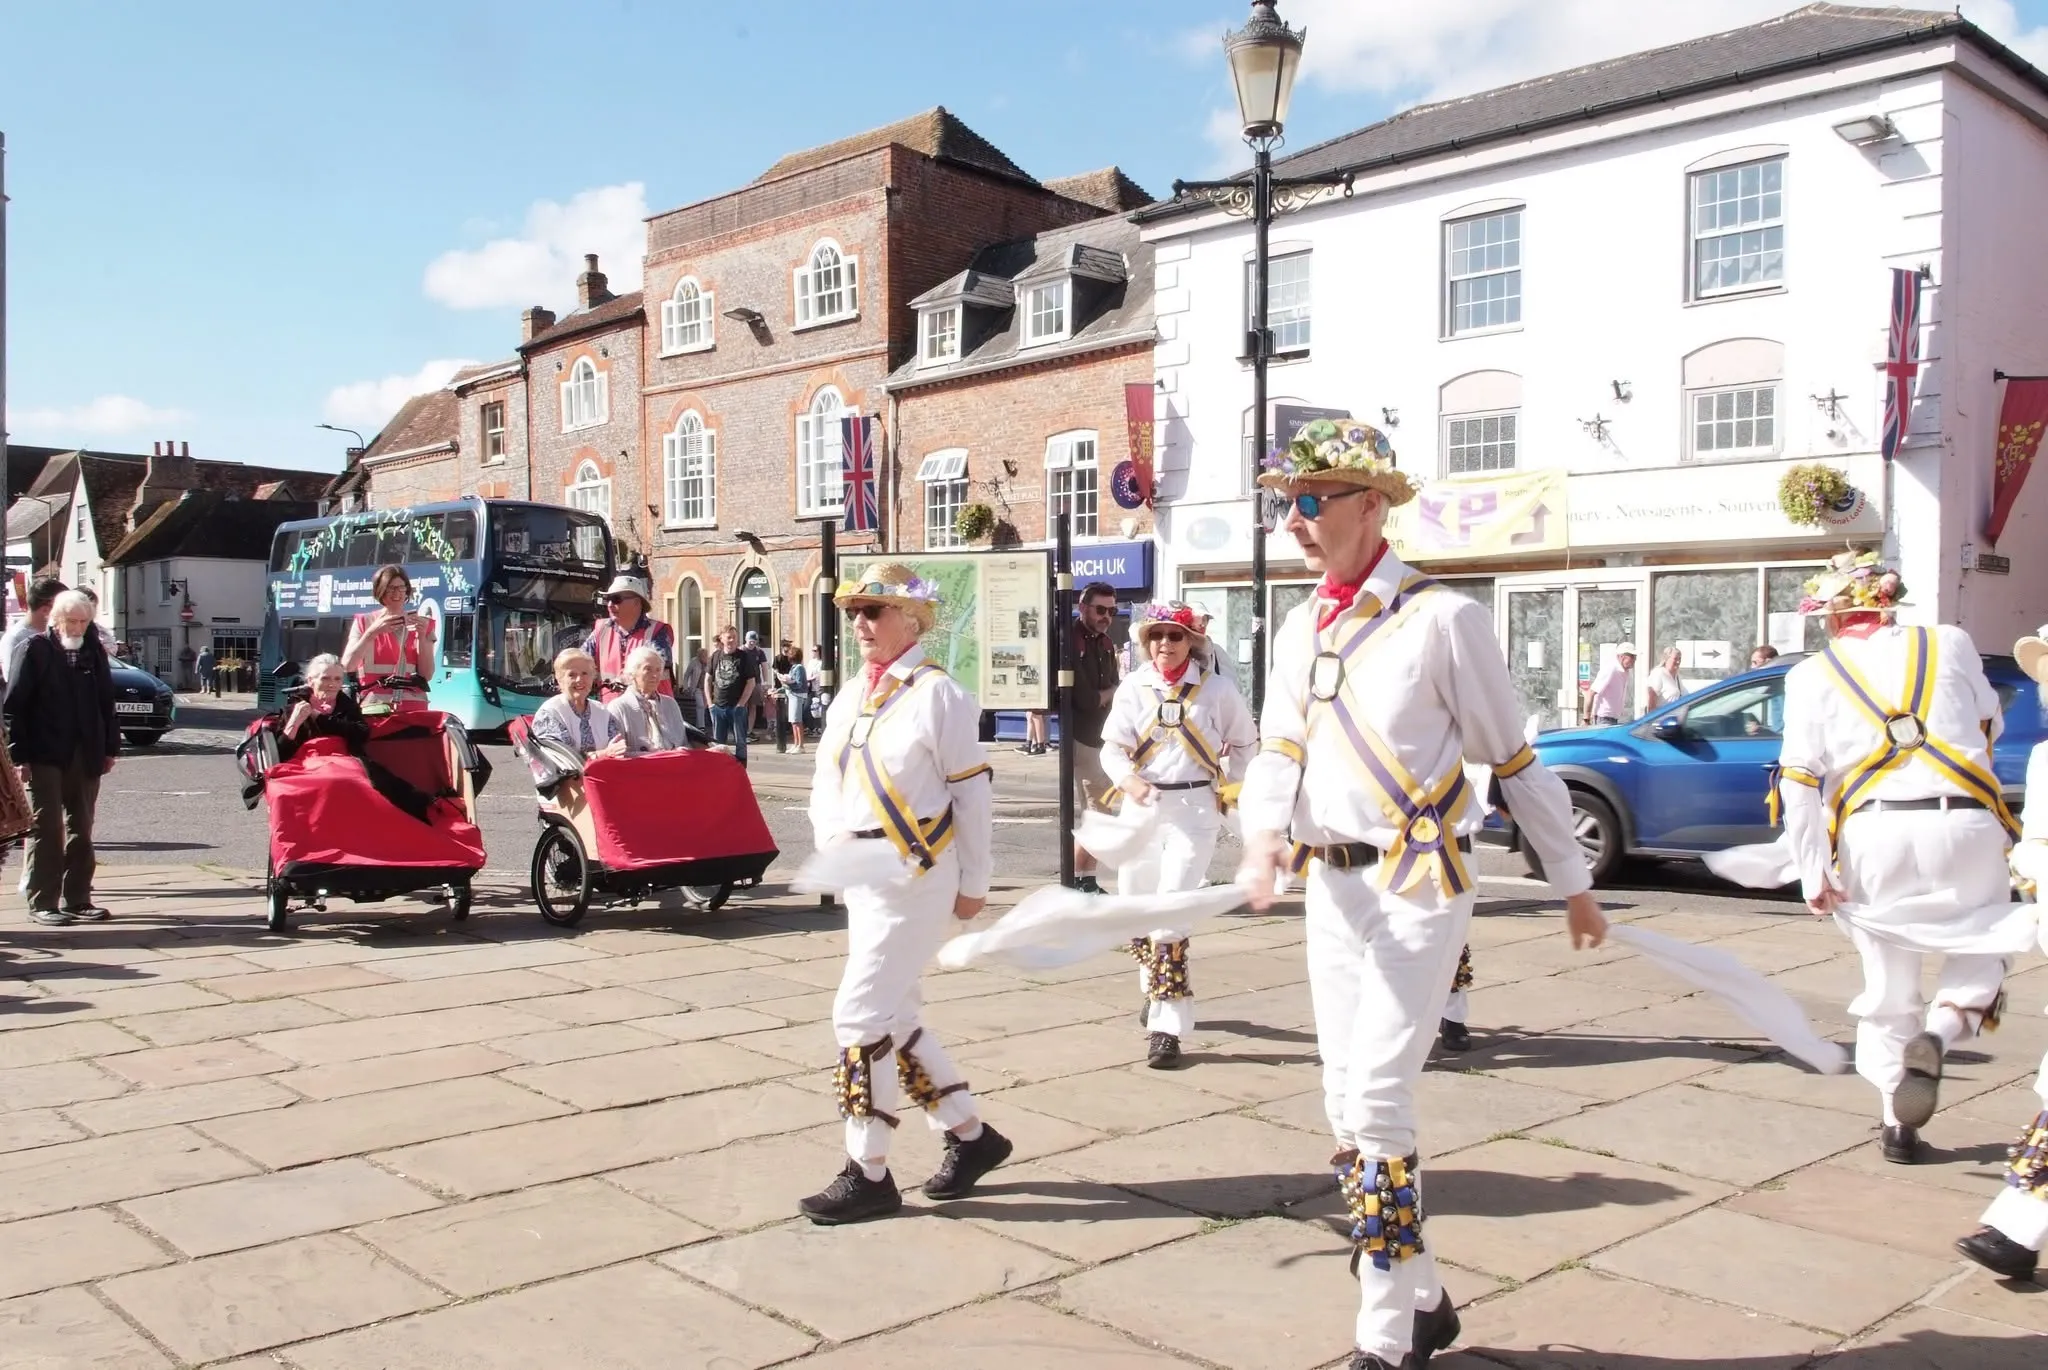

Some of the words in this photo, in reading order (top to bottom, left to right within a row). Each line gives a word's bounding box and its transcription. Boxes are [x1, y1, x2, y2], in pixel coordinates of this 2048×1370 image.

[1616, 503, 1704, 521] Newsagents
[1070, 559, 1103, 577] ARCH
[1106, 557, 1126, 575] UK
